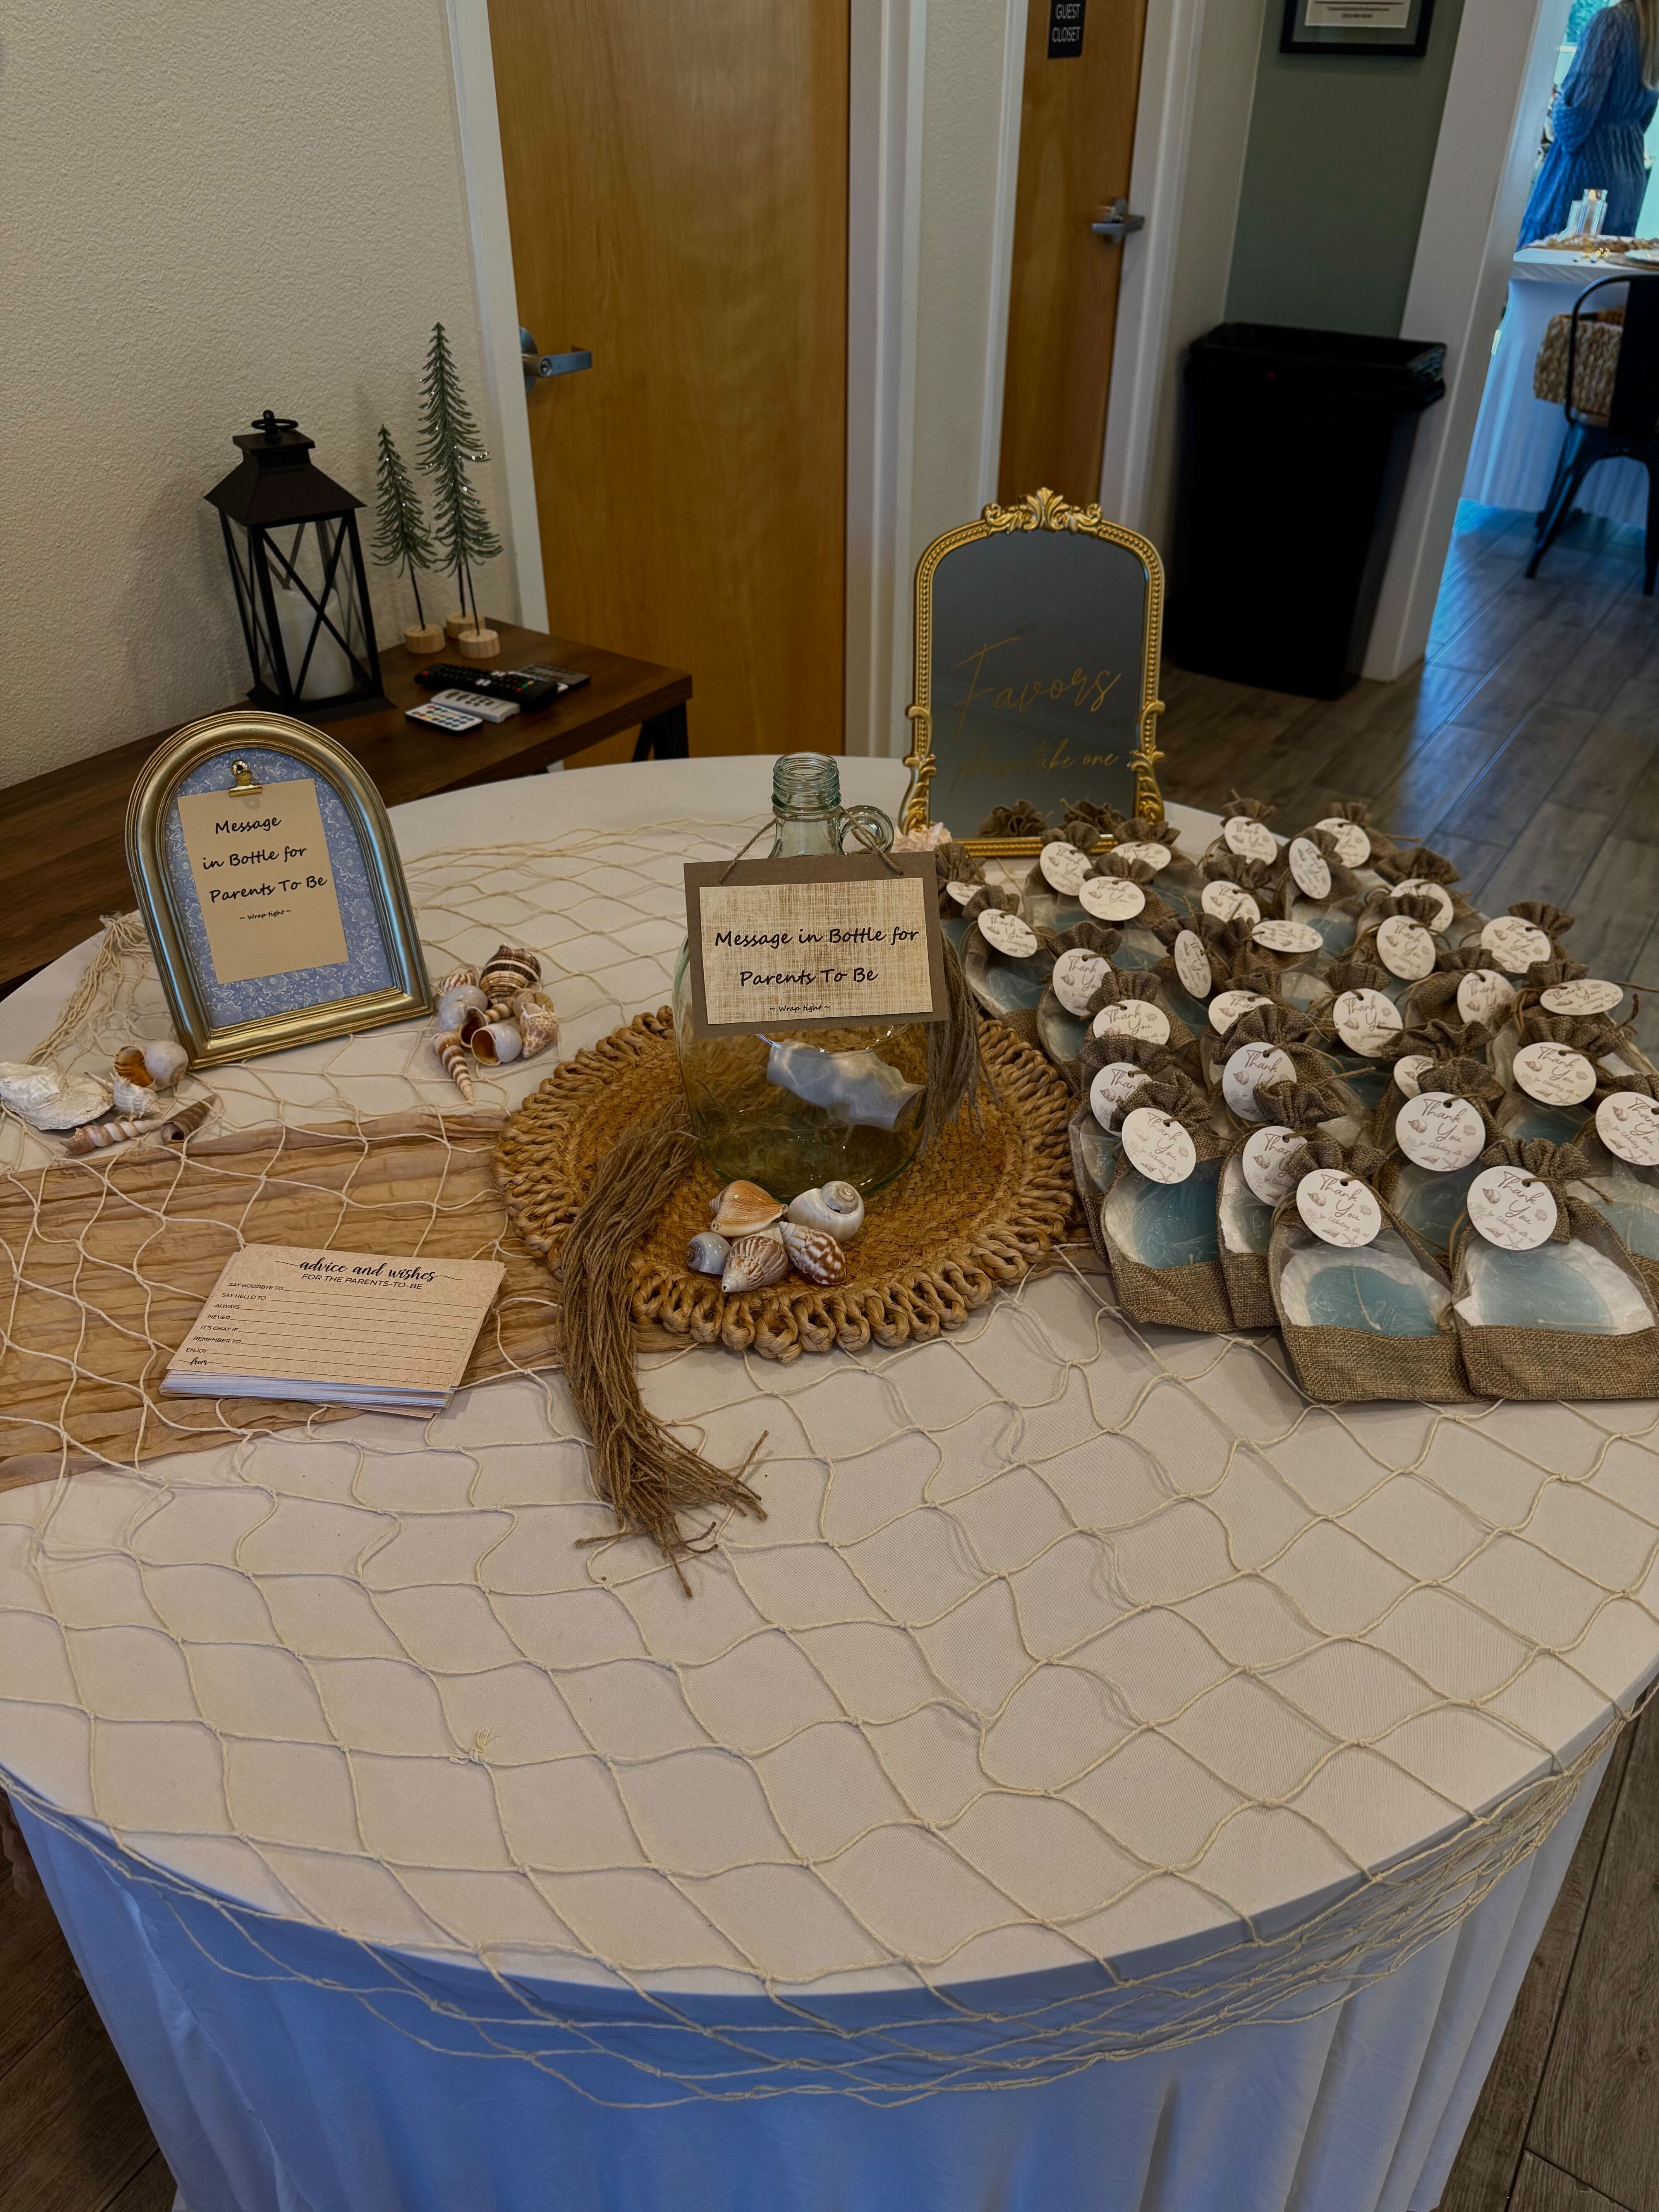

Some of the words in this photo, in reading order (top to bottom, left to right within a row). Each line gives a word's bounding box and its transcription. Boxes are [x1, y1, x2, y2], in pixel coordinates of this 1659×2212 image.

[1055, 3, 1081, 19] GUEST
[1051, 26, 1081, 43] CLOSET
[952, 637, 1122, 743] Favors
[1082, 752, 1119, 768] one
[215, 816, 282, 834] Message
[203, 857, 225, 870] in
[229, 850, 280, 866] Bottle
[284, 846, 307, 863] for
[210, 883, 276, 903] Parents
[278, 880, 302, 892] To
[306, 875, 328, 888] Be
[715, 931, 793, 949] Message
[799, 929, 824, 943] in
[829, 927, 887, 944] Bottle
[890, 926, 919, 946] for
[1068, 955, 1099, 974] Thank
[740, 969, 817, 986] Parents
[820, 969, 848, 982] To
[853, 967, 879, 982] Be
[802, 1004, 823, 1012] tight
[1104, 1004, 1142, 1024] Thank
[1342, 994, 1377, 1015] Thank
[1128, 1017, 1152, 1035] You
[1245, 1049, 1283, 1073] Thank
[1537, 1046, 1580, 1068] Thank
[1549, 1066, 1574, 1084] You
[1421, 1099, 1467, 1123] Thank
[1147, 1112, 1183, 1143] Thank
[1435, 1123, 1462, 1142] You
[1630, 1122, 1656, 1146] You
[1154, 1138, 1177, 1161] You
[1320, 1174, 1362, 1202] Thank
[1498, 1171, 1544, 1205] Thank
[1334, 1199, 1360, 1221] You
[1505, 1200, 1532, 1224] You
[275, 1257, 348, 1272] advice
[352, 1263, 387, 1276] and
[388, 1266, 462, 1282] wishes
[345, 1277, 424, 1290] PARENTS-TO-BE
[185, 1357, 214, 1366] from
